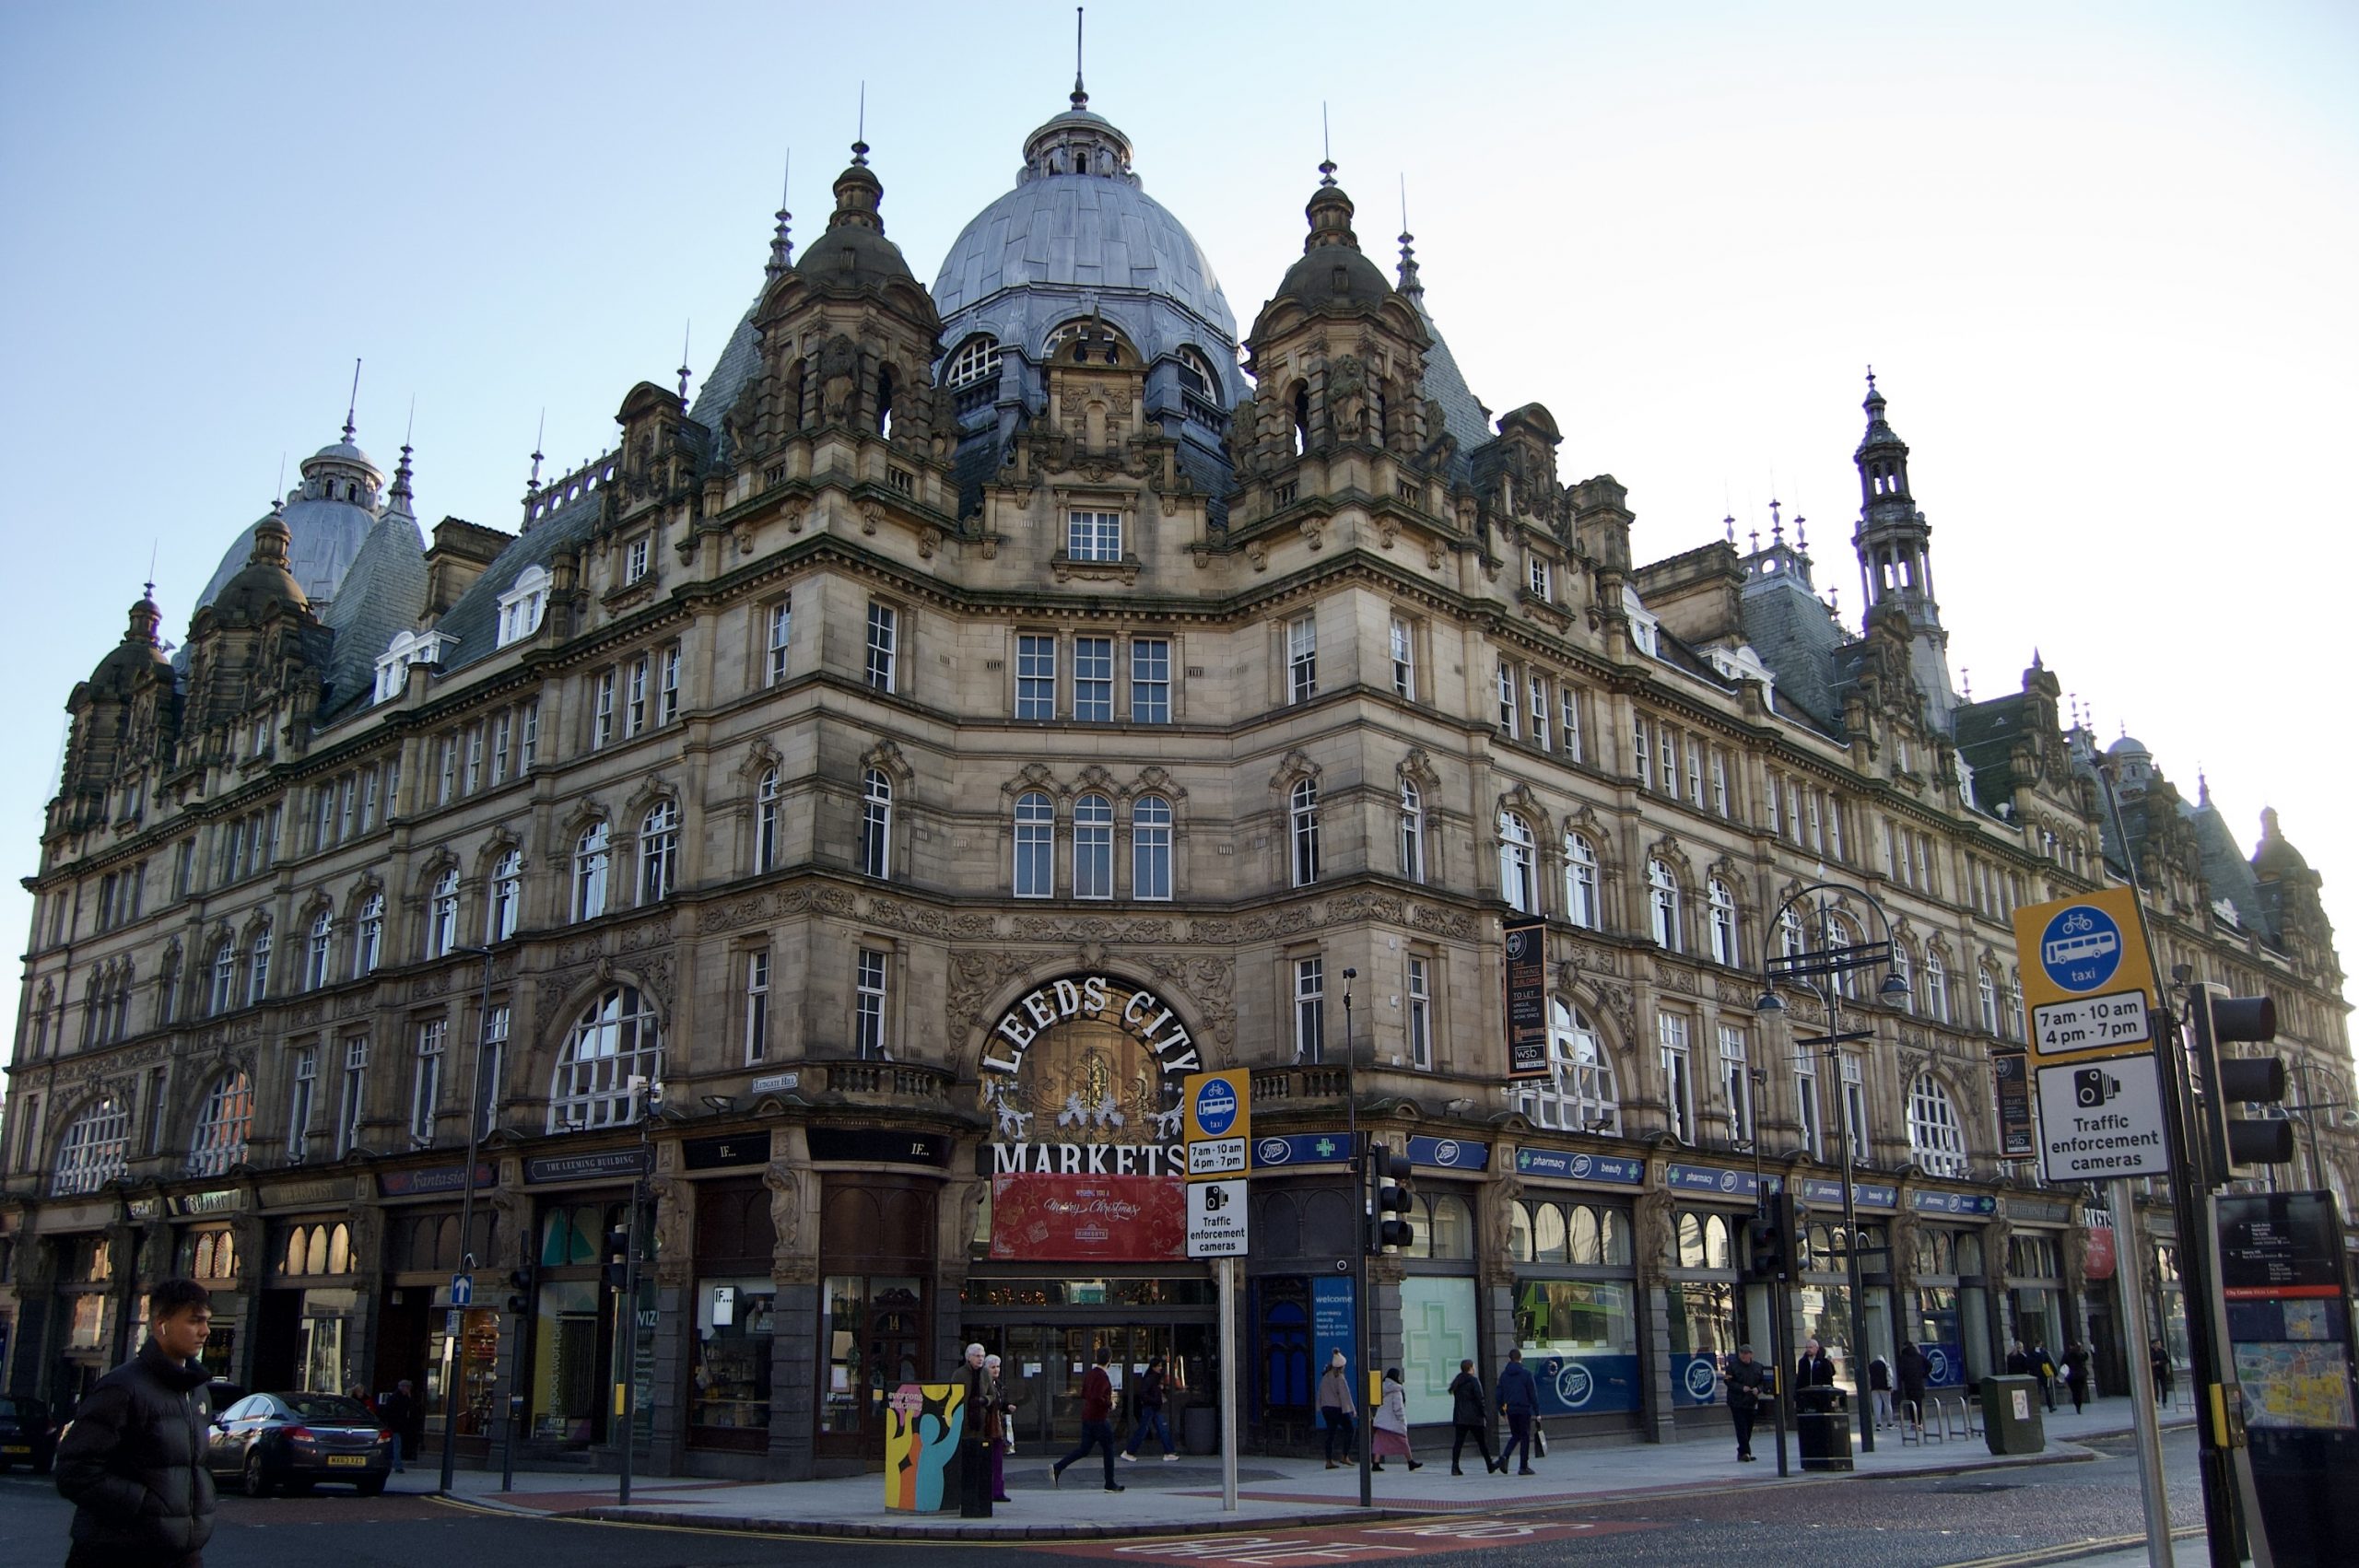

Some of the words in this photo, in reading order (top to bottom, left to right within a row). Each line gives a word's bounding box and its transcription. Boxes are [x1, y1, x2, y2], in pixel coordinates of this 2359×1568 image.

[2071, 968, 2095, 982] taxi
[2040, 1012, 2049, 1027] 7
[2051, 1012, 2077, 1026] am
[2090, 1003, 2109, 1020] 10
[2114, 1003, 2139, 1016] am
[983, 977, 1107, 1074] LEEDS
[1124, 990, 1200, 1074] CITY
[2045, 1030, 2058, 1045] 4
[2060, 1028, 2085, 1047] pm
[2098, 1024, 2107, 1037] 7
[2111, 1021, 2138, 1039] pm
[1516, 1048, 1538, 1059] wsb
[756, 1079, 780, 1089] LUDGATE
[781, 1077, 794, 1086] HILL
[1210, 1119, 1223, 1129] taxi
[2073, 1115, 2129, 1132] Traffic
[2051, 1129, 2159, 1153] enforcement
[1192, 1147, 1197, 1156] 7
[1217, 1144, 1227, 1153] 10
[1229, 1144, 1242, 1153] am
[546, 1163, 559, 1172] THE
[562, 1158, 595, 1170] LEEMING
[597, 1154, 634, 1166] BUILDING
[992, 1142, 1185, 1176] MARKETS
[1193, 1158, 1200, 1167] 4
[1202, 1159, 1215, 1169] pm
[1221, 1157, 1226, 1165] 7
[1227, 1157, 1240, 1167] pm
[2071, 1153, 2142, 1170] cameras
[1532, 1157, 1566, 1171] pharmacy
[1601, 1162, 1623, 1176] beauty
[409, 1169, 465, 1191] Fantasia
[1686, 1173, 1714, 1185] pharmacy
[1818, 1187, 1840, 1197] pharmacy
[1868, 1191, 1883, 1201] beauty
[1043, 1198, 1088, 1216] Merry
[1088, 1199, 1142, 1222] Christmas
[1925, 1197, 1944, 1206] pharmacy
[1962, 1200, 1975, 1210] beauty
[1203, 1217, 1231, 1226] Traffic
[1191, 1228, 1245, 1240] enforcement
[1200, 1242, 1236, 1252] cameras
[716, 1291, 733, 1303] IF...
[1316, 1294, 1353, 1303] welcome
[889, 1316, 899, 1329] 14
[887, 1392, 923, 1402] everyone
[888, 1401, 923, 1411] welcome
[1360, 1520, 1595, 1539] BUS
[1113, 1537, 1416, 1565] GATE
